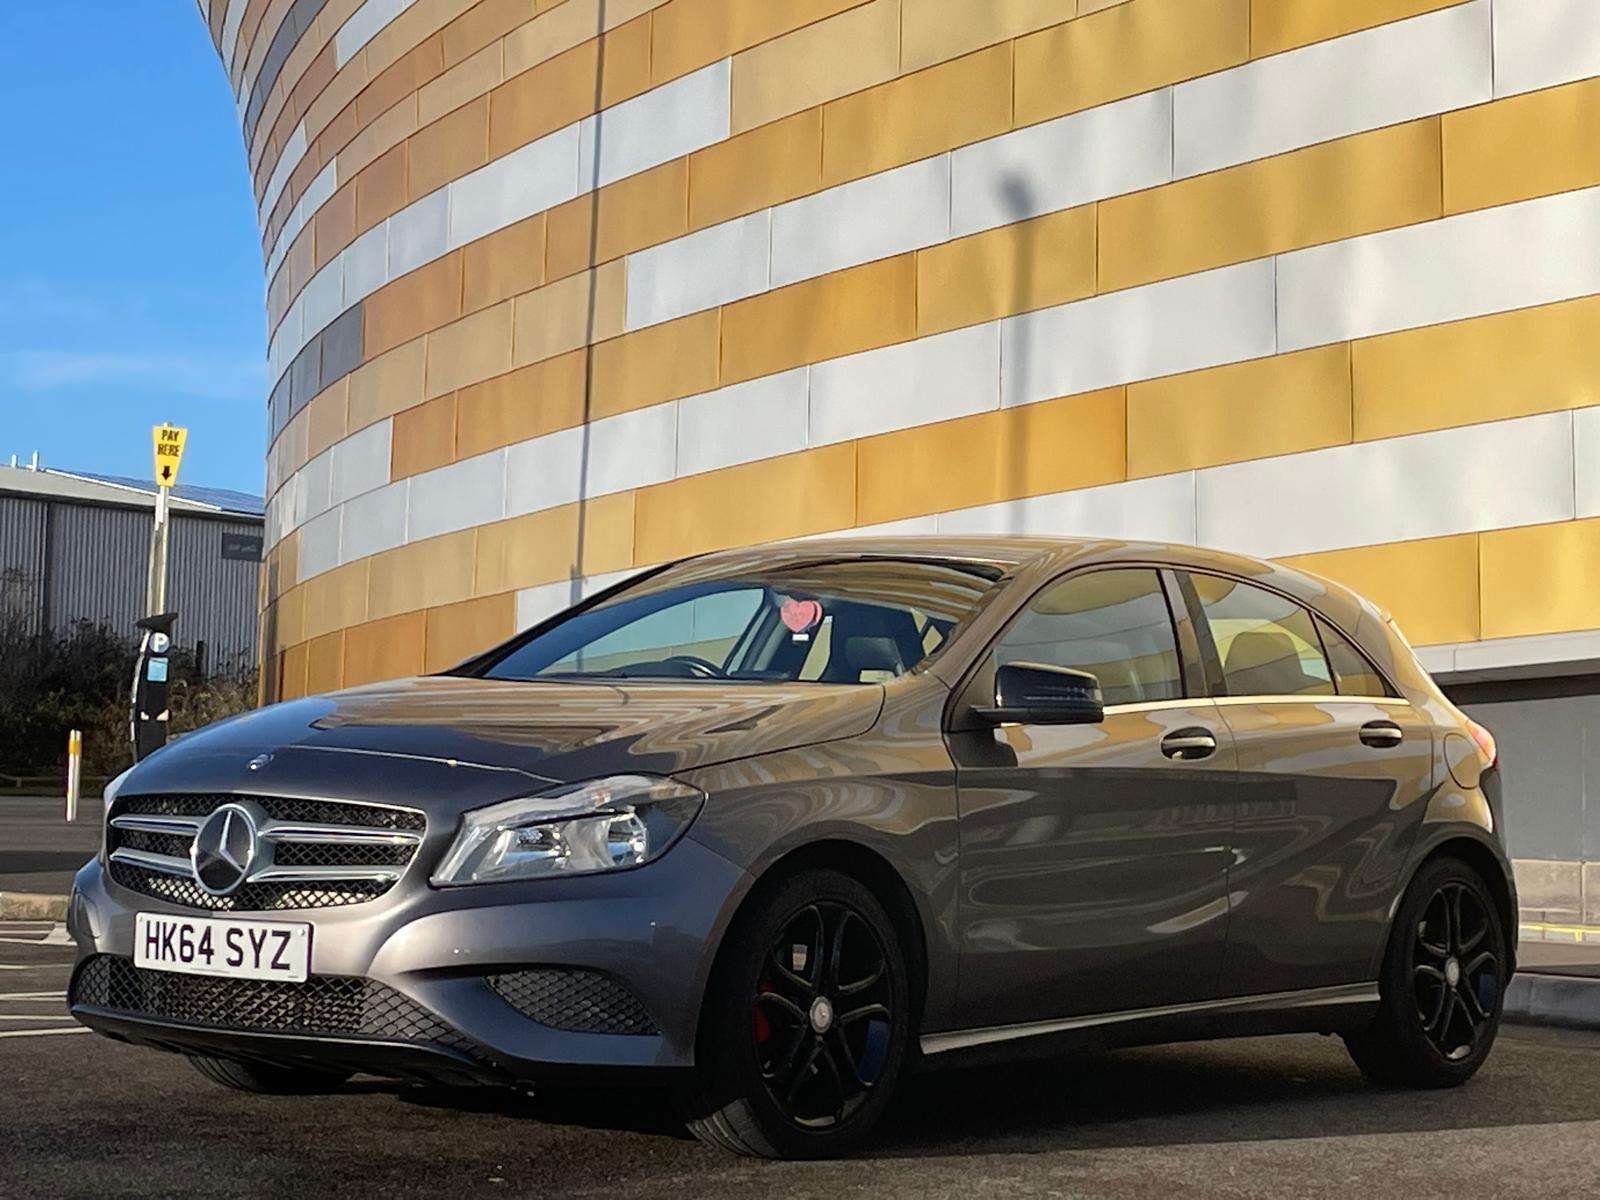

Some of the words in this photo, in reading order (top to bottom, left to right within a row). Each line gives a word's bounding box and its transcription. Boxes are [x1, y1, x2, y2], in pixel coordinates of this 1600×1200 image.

[162, 429, 179, 441] PAY
[153, 633, 169, 652] P
[145, 920, 215, 965] HK64
[225, 927, 291, 971] SYZ
